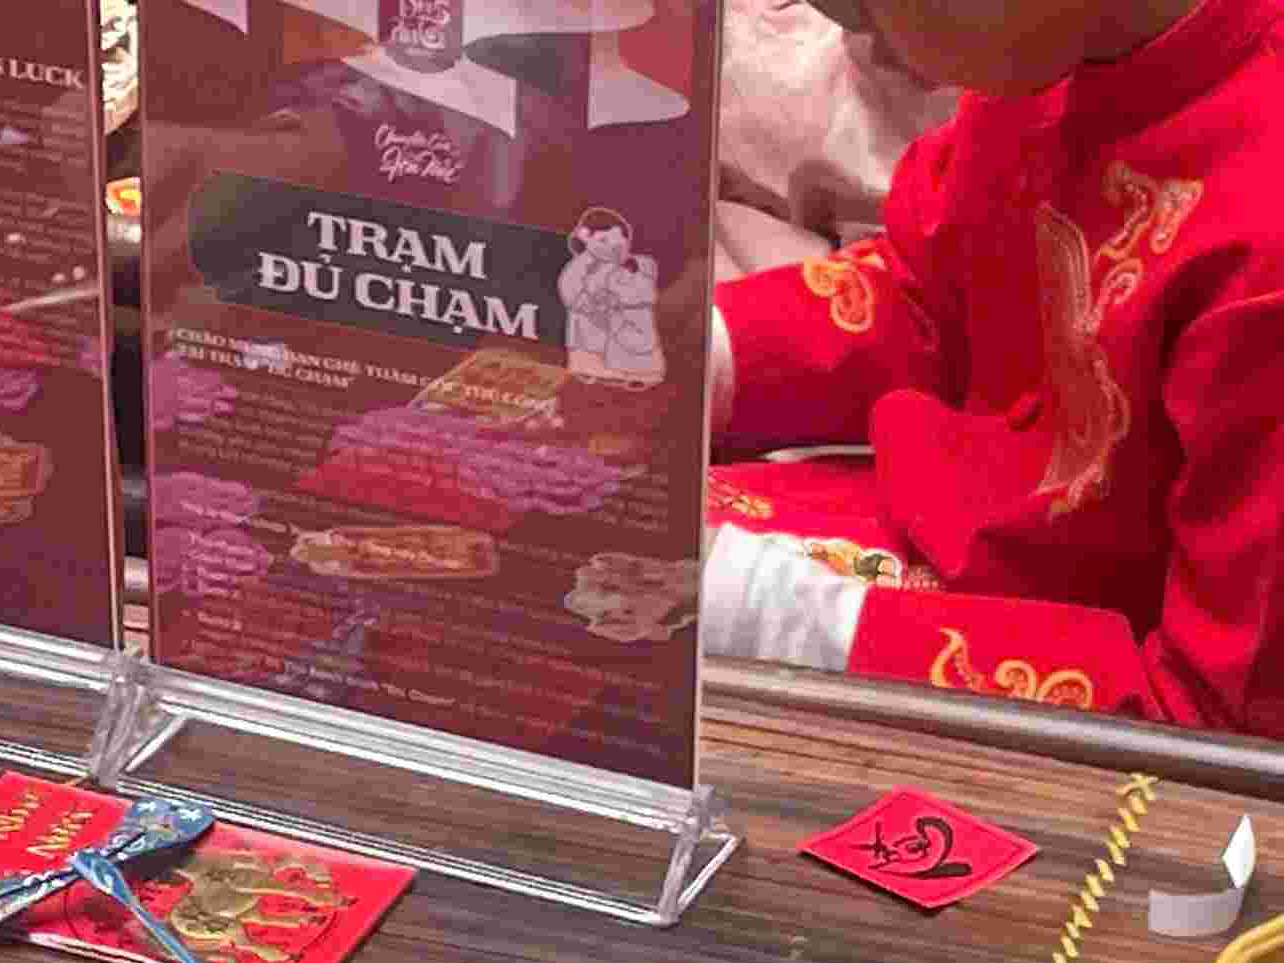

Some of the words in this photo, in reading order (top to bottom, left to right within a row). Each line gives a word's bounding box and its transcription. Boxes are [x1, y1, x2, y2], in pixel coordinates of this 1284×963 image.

[9, 57, 85, 88] LUCK
[306, 211, 488, 280] TRẠM
[257, 252, 344, 300] ĐỦ
[354, 272, 541, 340] CHẠM
